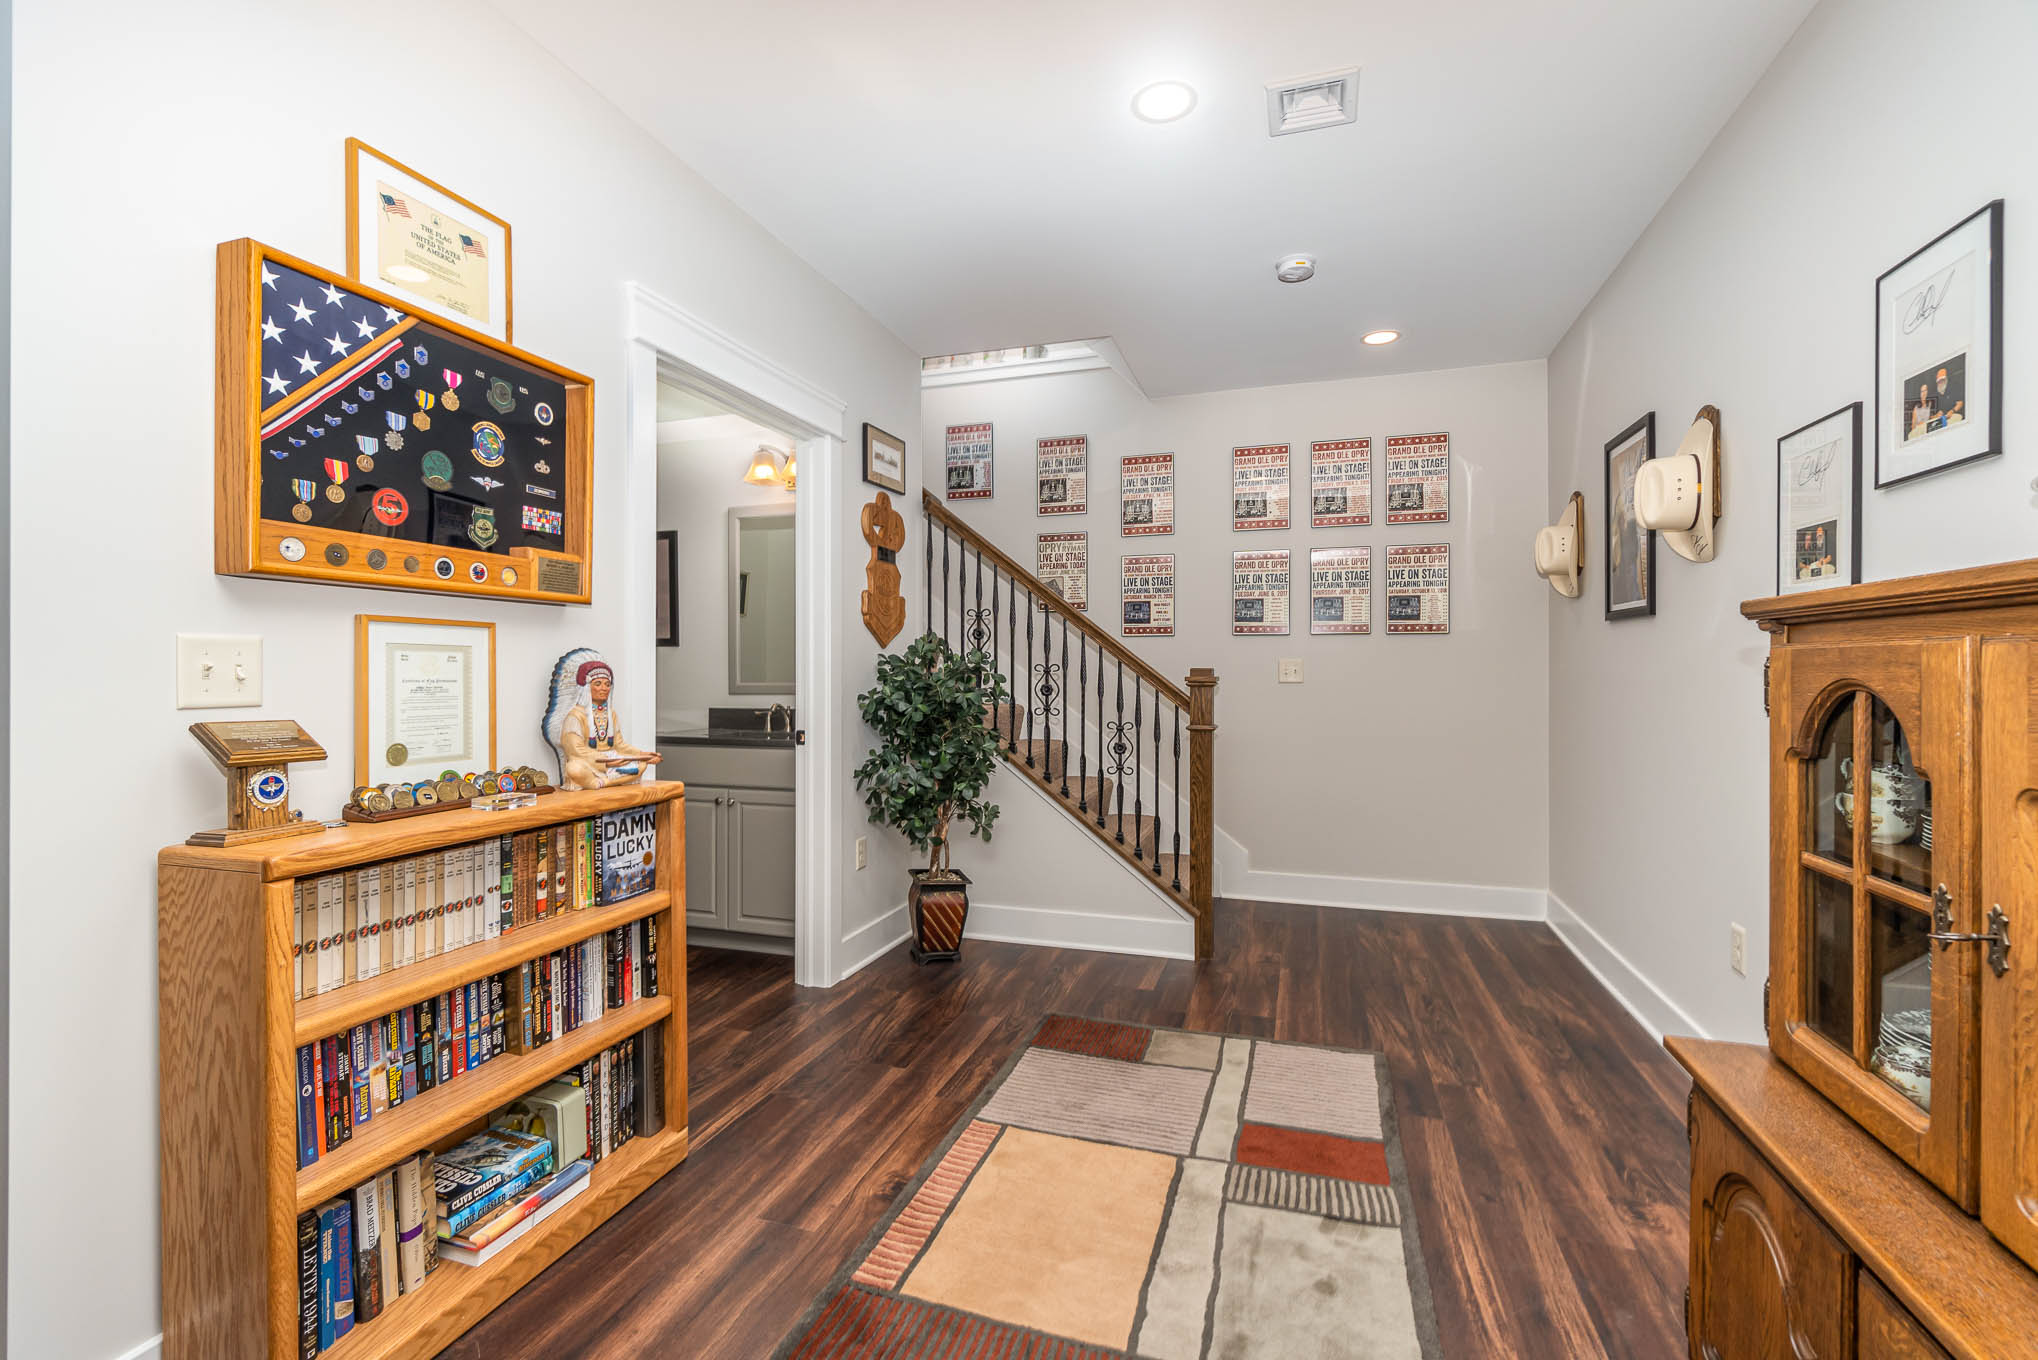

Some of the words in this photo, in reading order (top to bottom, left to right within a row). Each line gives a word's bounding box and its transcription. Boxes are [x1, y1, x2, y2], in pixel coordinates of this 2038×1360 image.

[420, 224, 434, 233] THE
[436, 232, 452, 244] FLAG
[410, 232, 436, 248] UNITED
[438, 244, 461, 260] STATES
[427, 248, 456, 264] AMERICA
[1313, 452, 1335, 460] GRAND
[1337, 451, 1349, 459] OLE
[1351, 450, 1368, 458] OPRY
[1388, 447, 1411, 455] GRAND
[1428, 444, 1447, 453] OPRY
[1271, 455, 1288, 463] OPRY
[1388, 460, 1406, 470] LIVE!
[1409, 460, 1418, 469] ON
[1421, 458, 1447, 468] STAGE!
[1235, 470, 1251, 480] LIVE!
[1253, 469, 1262, 479] ON
[1265, 468, 1288, 477] STAGE!
[1313, 465, 1330, 475] LIVE!
[1333, 464, 1342, 474] ON
[1344, 463, 1368, 473] STAGE!
[1123, 478, 1138, 488] LIVE!
[1140, 477, 1148, 486] ON
[1150, 476, 1172, 485] STAGE!
[381, 494, 399, 513] 5
[1040, 543, 1061, 553] OPRY
[1040, 553, 1052, 562] LIVE
[1055, 553, 1063, 562] ON
[1066, 552, 1085, 561] STAGE
[1388, 556, 1411, 564] GRAND
[1428, 555, 1447, 563] OPRY
[1235, 561, 1256, 569] GRAND
[1235, 574, 1250, 584] LIVE
[1252, 574, 1262, 583] ON
[1265, 573, 1288, 583] STAGE
[1313, 572, 1329, 581] LIVE
[1331, 572, 1342, 581] ON
[1344, 570, 1369, 581] STAGE
[1388, 570, 1405, 580] LIVE
[1408, 569, 1419, 579] ON
[1422, 568, 1447, 579] STAGE
[1124, 578, 1138, 587] LIVE
[1140, 577, 1149, 586] ON
[1152, 577, 1173, 586] STAGE
[604, 812, 656, 842] DAMN
[607, 834, 653, 860] LUCKY
[360, 1085, 368, 1115] MEDUSA
[452, 1192, 472, 1210] CLIVE
[473, 1175, 501, 1196] CUSSLER
[366, 1195, 374, 1216] BRAD
[455, 1213, 476, 1232] CLIVE
[478, 1193, 506, 1216] CUSSLER
[368, 1217, 376, 1248] MELTZER
[338, 1227, 349, 1253] BRAD
[304, 1244, 317, 1299] LEYTE
[339, 1254, 350, 1298] MELTZER
[304, 1299, 318, 1334] 1944
